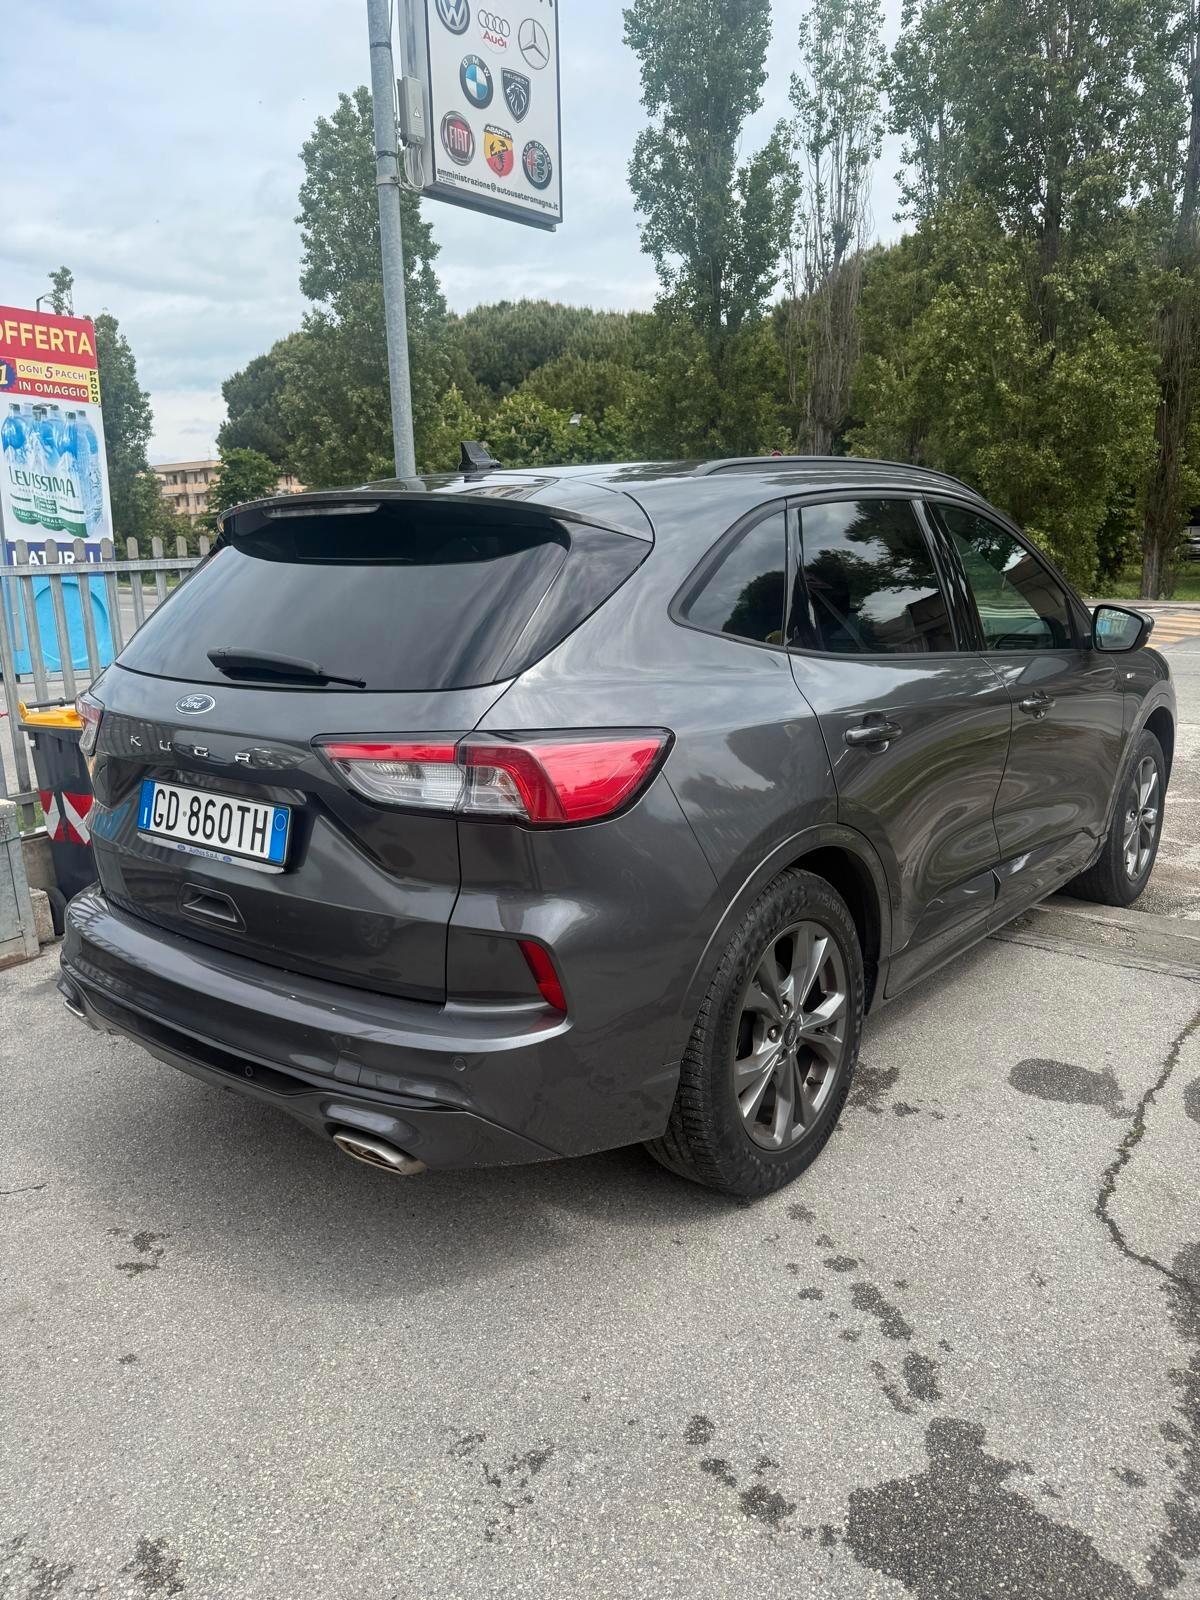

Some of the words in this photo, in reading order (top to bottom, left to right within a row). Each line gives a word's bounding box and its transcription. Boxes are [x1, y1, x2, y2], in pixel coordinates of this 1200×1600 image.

[462, 55, 491, 77] BMW
[503, 72, 528, 85] PEUGEOT
[449, 126, 469, 153] FIAT
[486, 126, 512, 139] ABARTH
[0, 320, 94, 356] FFERTA
[18, 364, 43, 375] OGNI
[44, 366, 53, 379] 5
[56, 370, 87, 380] PACCHI
[19, 381, 32, 391] IN
[35, 383, 88, 398] OMAGGIO
[89, 371, 99, 403] PROMO
[9, 465, 76, 498] LEVISSIMA
[180, 695, 208, 711] Ford
[130, 735, 251, 763] KUGA
[153, 788, 180, 831] GD
[187, 795, 269, 853] 860TH
